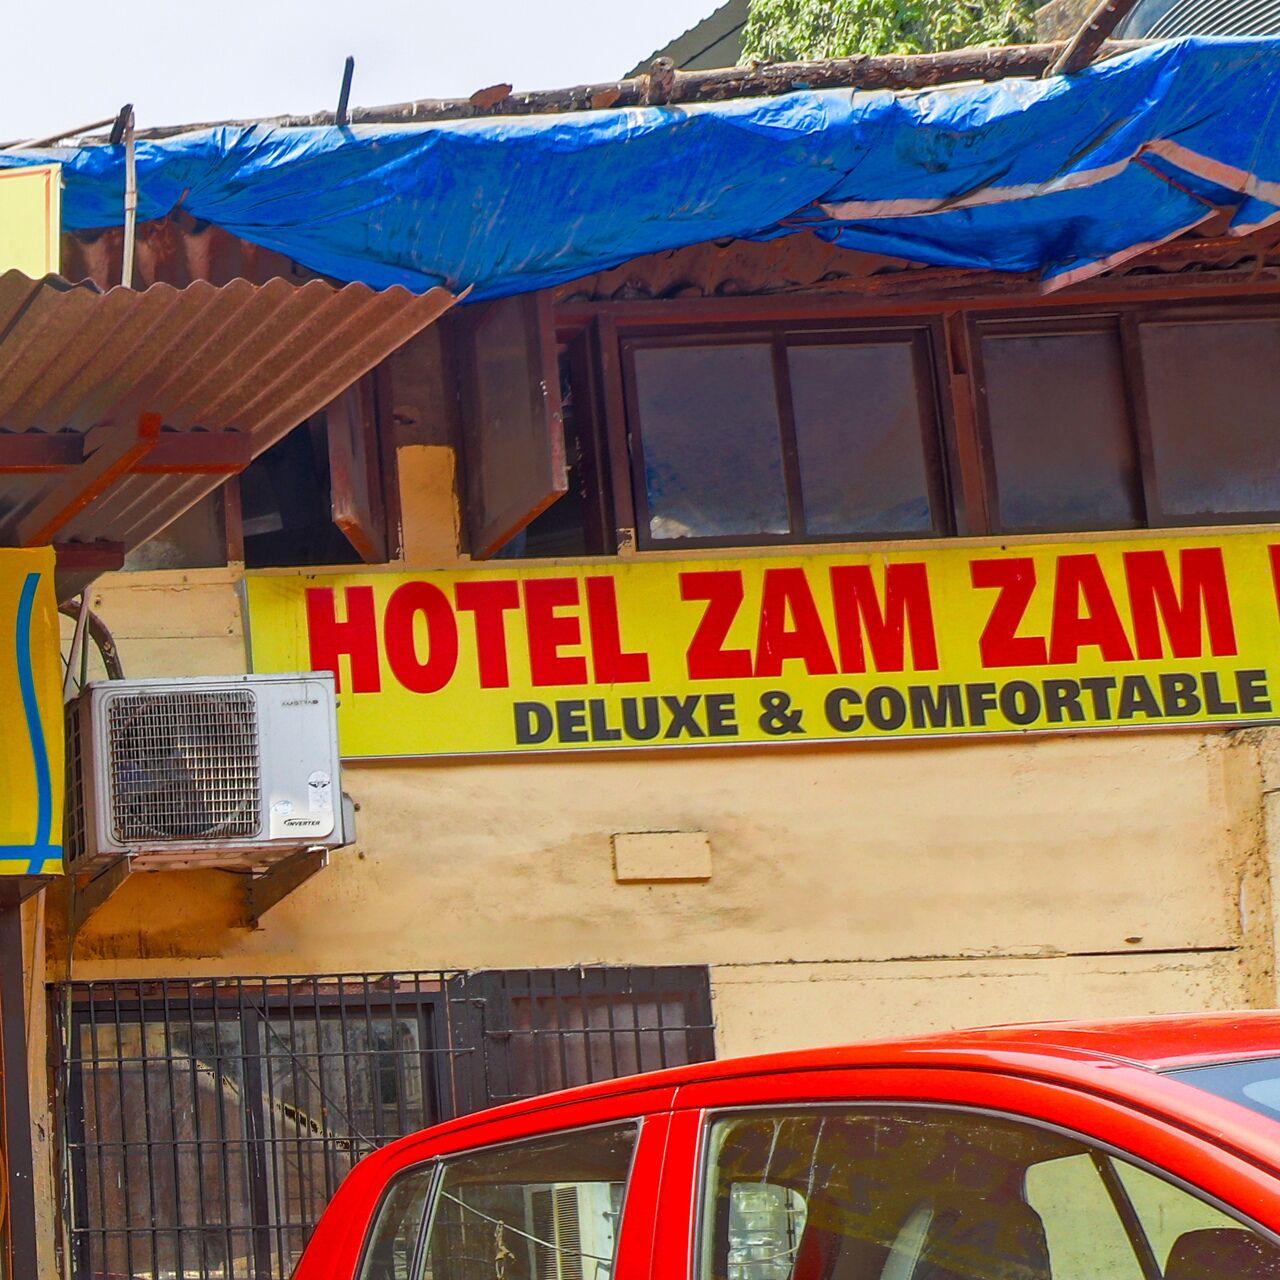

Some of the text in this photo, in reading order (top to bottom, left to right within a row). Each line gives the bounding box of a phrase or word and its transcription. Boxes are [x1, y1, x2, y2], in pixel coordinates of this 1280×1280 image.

[305, 576, 650, 695] HOTEL
[679, 562, 938, 680] ZAM
[969, 546, 1238, 669] ZAM
[513, 668, 1273, 745] DELUXE & COMFORTABLE
[285, 819, 321, 827] INVERTER
